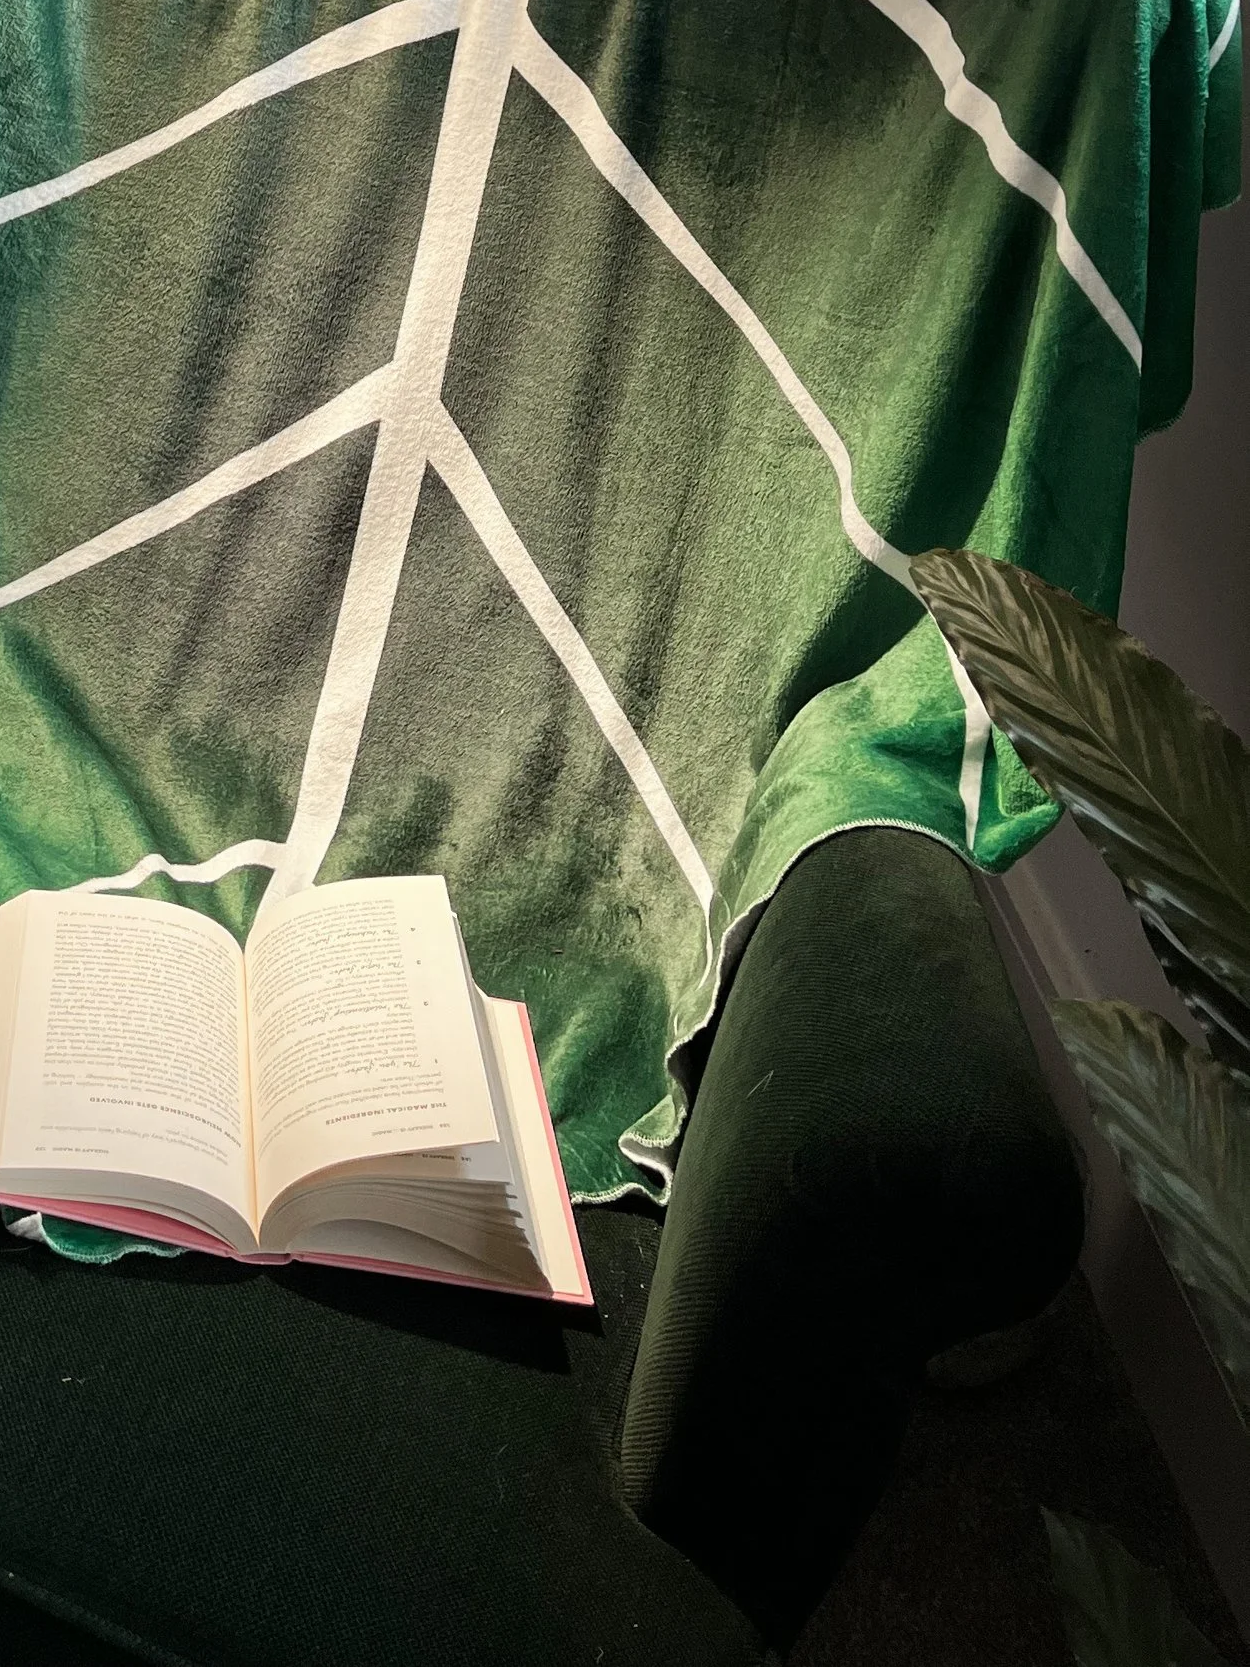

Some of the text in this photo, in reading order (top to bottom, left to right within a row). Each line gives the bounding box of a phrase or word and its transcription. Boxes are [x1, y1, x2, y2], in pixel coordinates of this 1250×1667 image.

[88, 1096, 242, 1148] HOW NEUROSCIENCE GETS INVOLVED
[324, 1102, 448, 1126] THE MAGICAL INGREDIENTS
